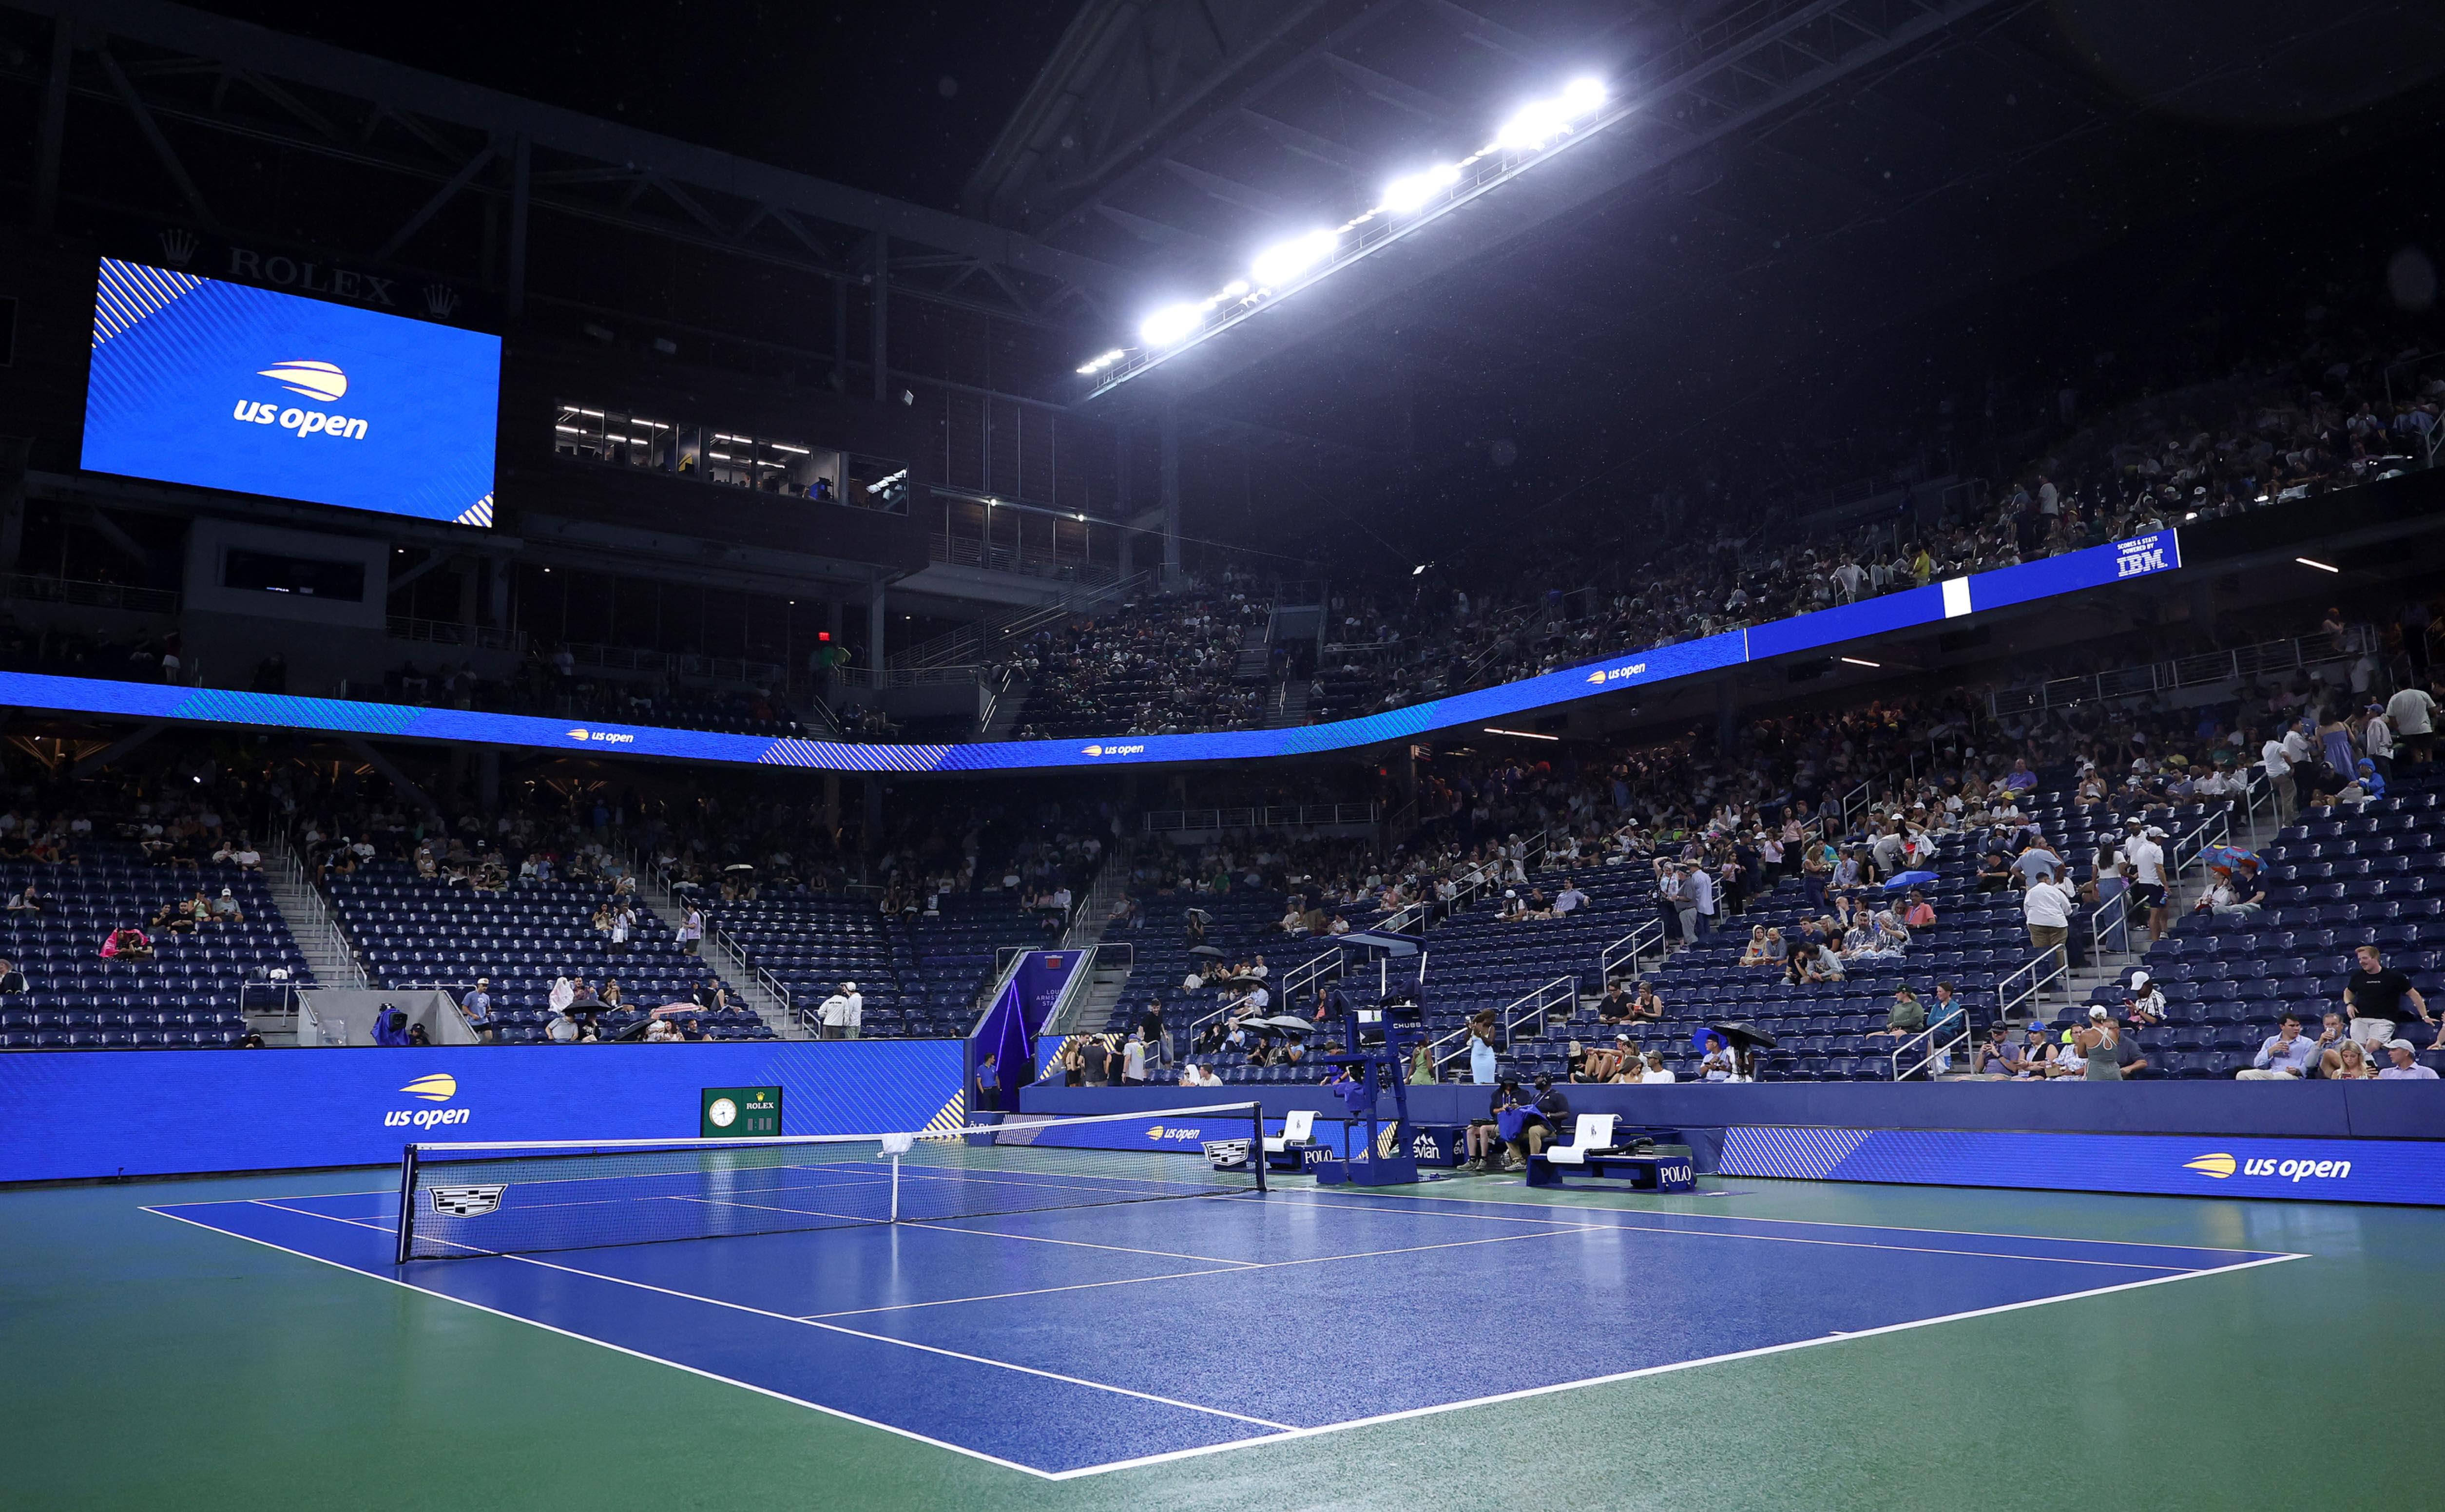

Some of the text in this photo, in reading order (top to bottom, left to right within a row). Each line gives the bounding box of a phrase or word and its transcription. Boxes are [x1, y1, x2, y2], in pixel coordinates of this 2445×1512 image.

[227, 247, 397, 307] ROLEX
[233, 399, 368, 440] us open
[2117, 540, 2137, 550] SCORES
[2141, 536, 2158, 544] STATS
[2122, 545, 2146, 555] POWERED
[2117, 549, 2165, 577] IBM
[1608, 663, 1646, 680] us open
[591, 732, 634, 744] us open
[1104, 745, 1144, 756] us open
[746, 1102, 774, 1110] ROLEX
[384, 1109, 470, 1130] us open
[1164, 1129, 1200, 1143] us open
[1304, 1149, 1333, 1164] POLO
[1413, 1144, 1441, 1159] evian
[1660, 1165, 1691, 1183] POLO
[2244, 1158, 2351, 1183] us open
